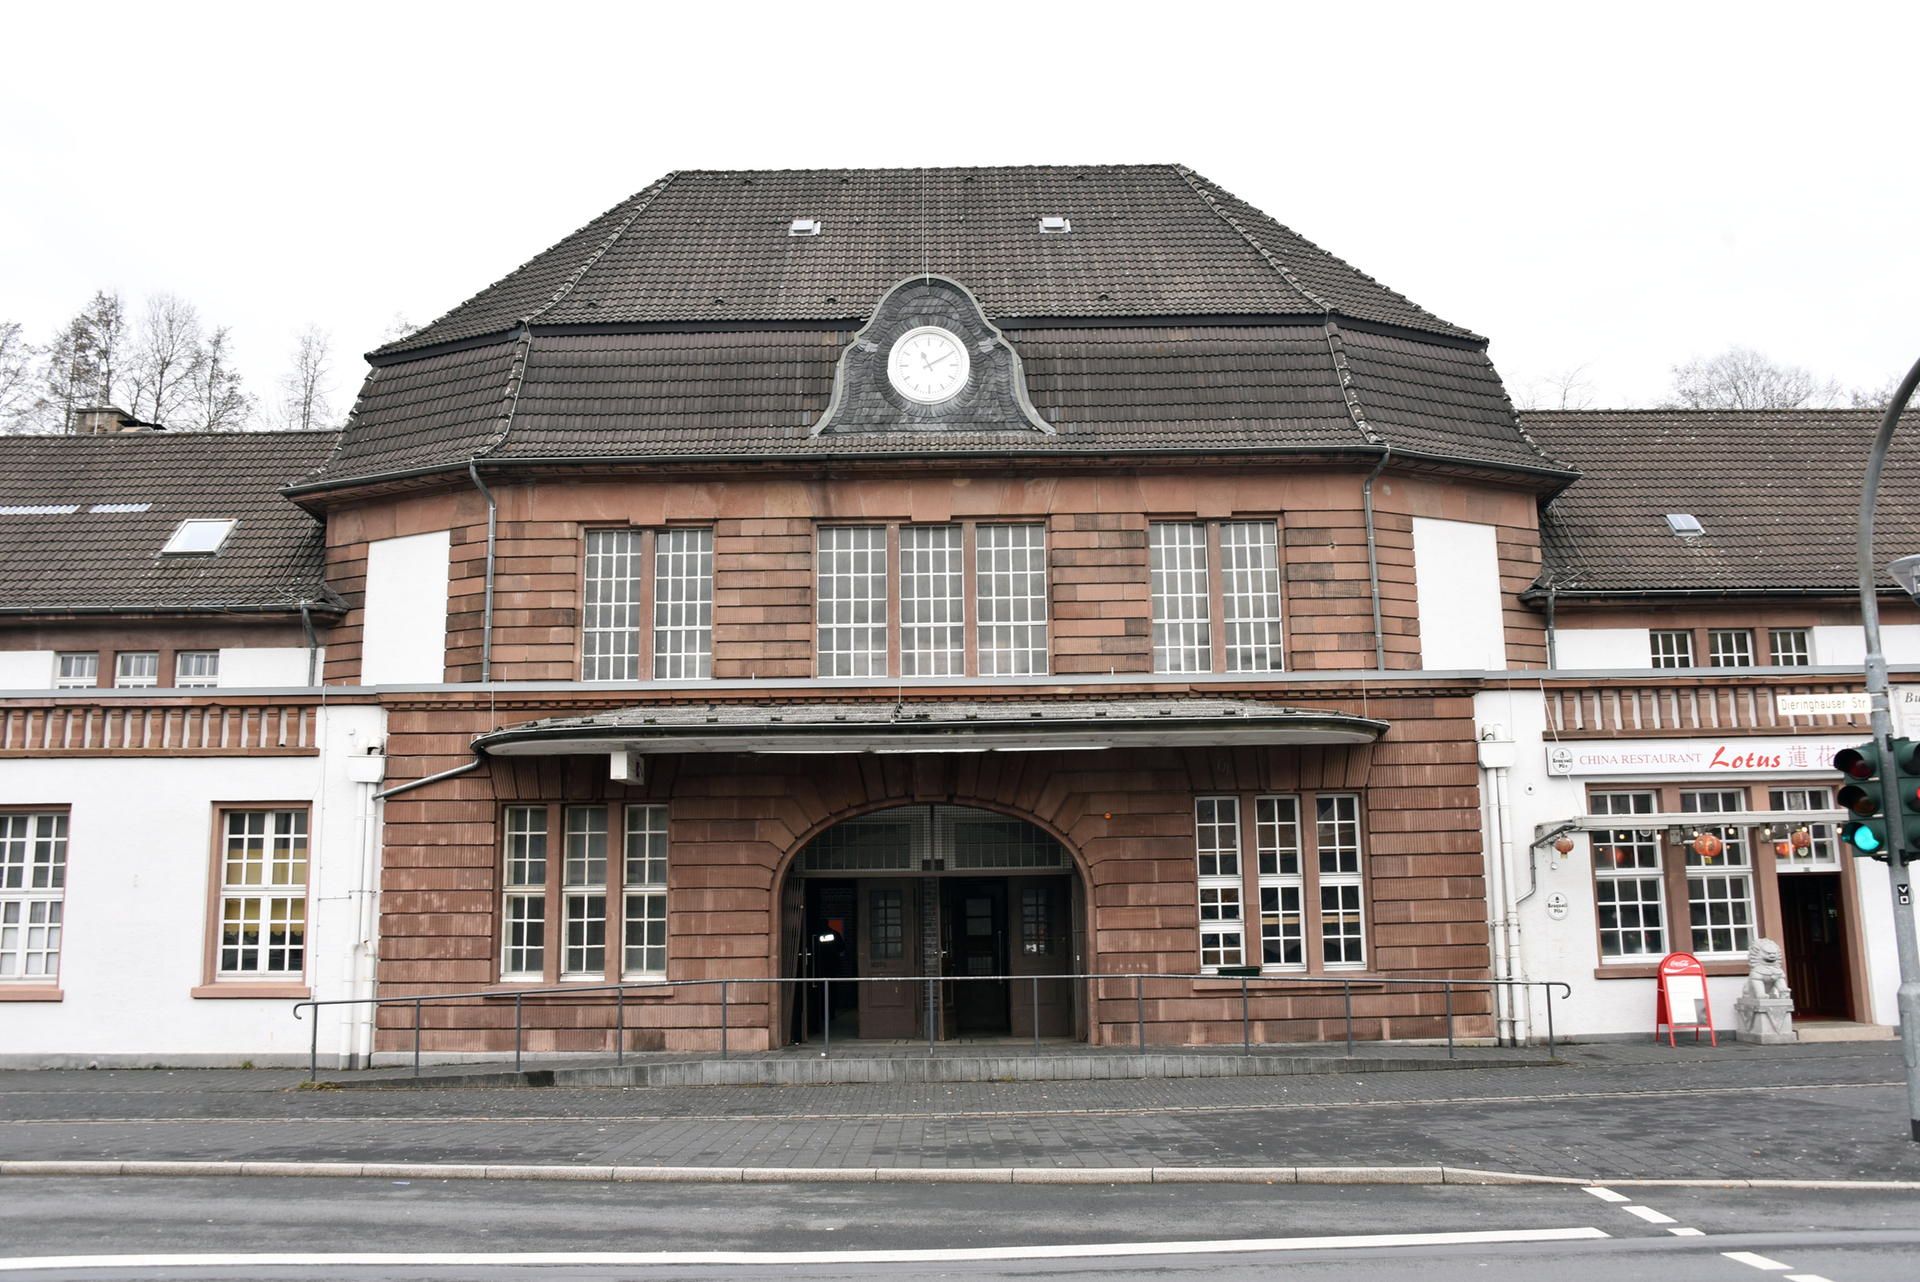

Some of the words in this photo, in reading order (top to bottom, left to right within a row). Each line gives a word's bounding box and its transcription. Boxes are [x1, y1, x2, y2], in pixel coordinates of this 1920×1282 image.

[1782, 698, 1845, 712] Dieringhauser
[1579, 754, 1618, 765] CHINA
[1621, 753, 1702, 764] RESTAURANT
[1709, 746, 1781, 768] Lotus
